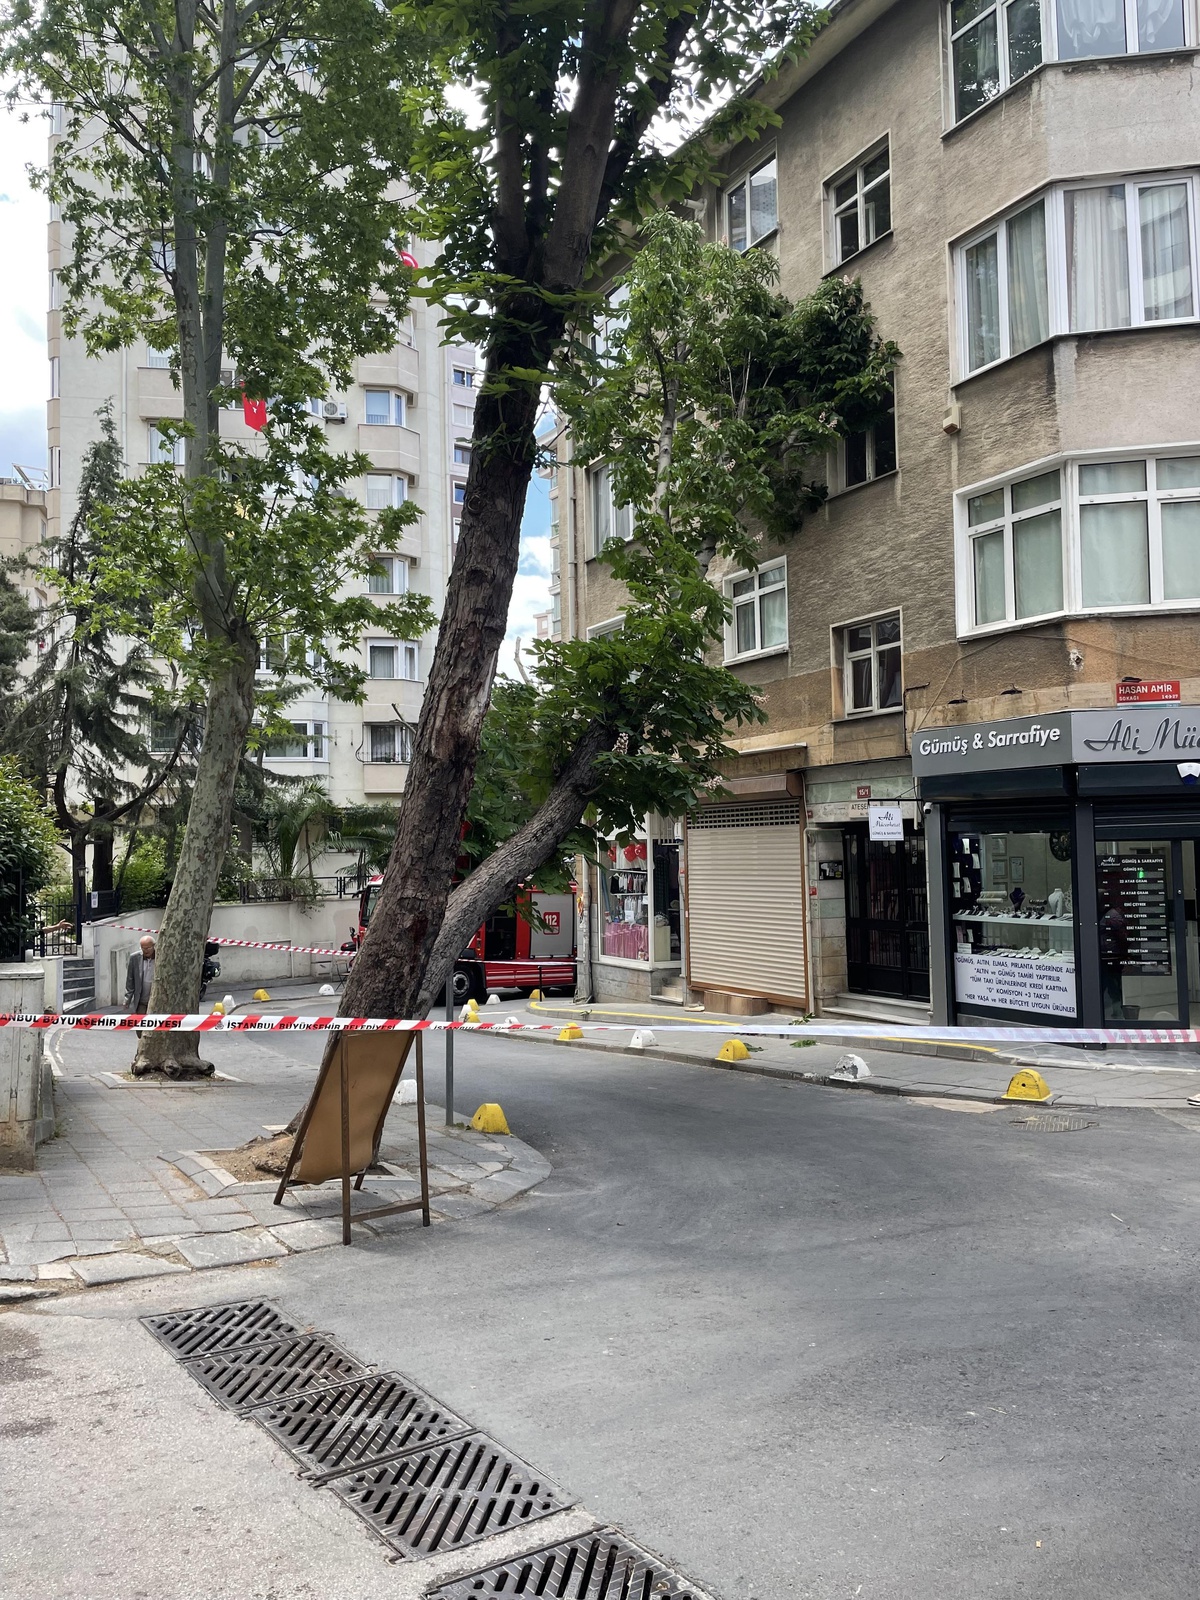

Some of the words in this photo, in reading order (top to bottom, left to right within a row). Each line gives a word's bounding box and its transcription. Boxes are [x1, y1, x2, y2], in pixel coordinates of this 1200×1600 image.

[1119, 686, 1148, 694] HASAN
[1151, 684, 1172, 692] AMİR
[1083, 718, 1140, 751] Ali
[920, 736, 968, 755] Gümüş
[972, 733, 983, 749] &
[988, 725, 1060, 748] Sarrafiye
[545, 915, 557, 925] 112
[1036, 964, 1063, 973] DEĞERİNDE
[996, 978, 1027, 988] ÜRÜNLERİNDE
[996, 988, 1022, 996] KOMİSYON
[1010, 998, 1029, 1007] BÜTÇEYE
[1052, 1003, 1075, 1013] ÜRÜNLER
[227, 1020, 274, 1029] İSTANBUL
